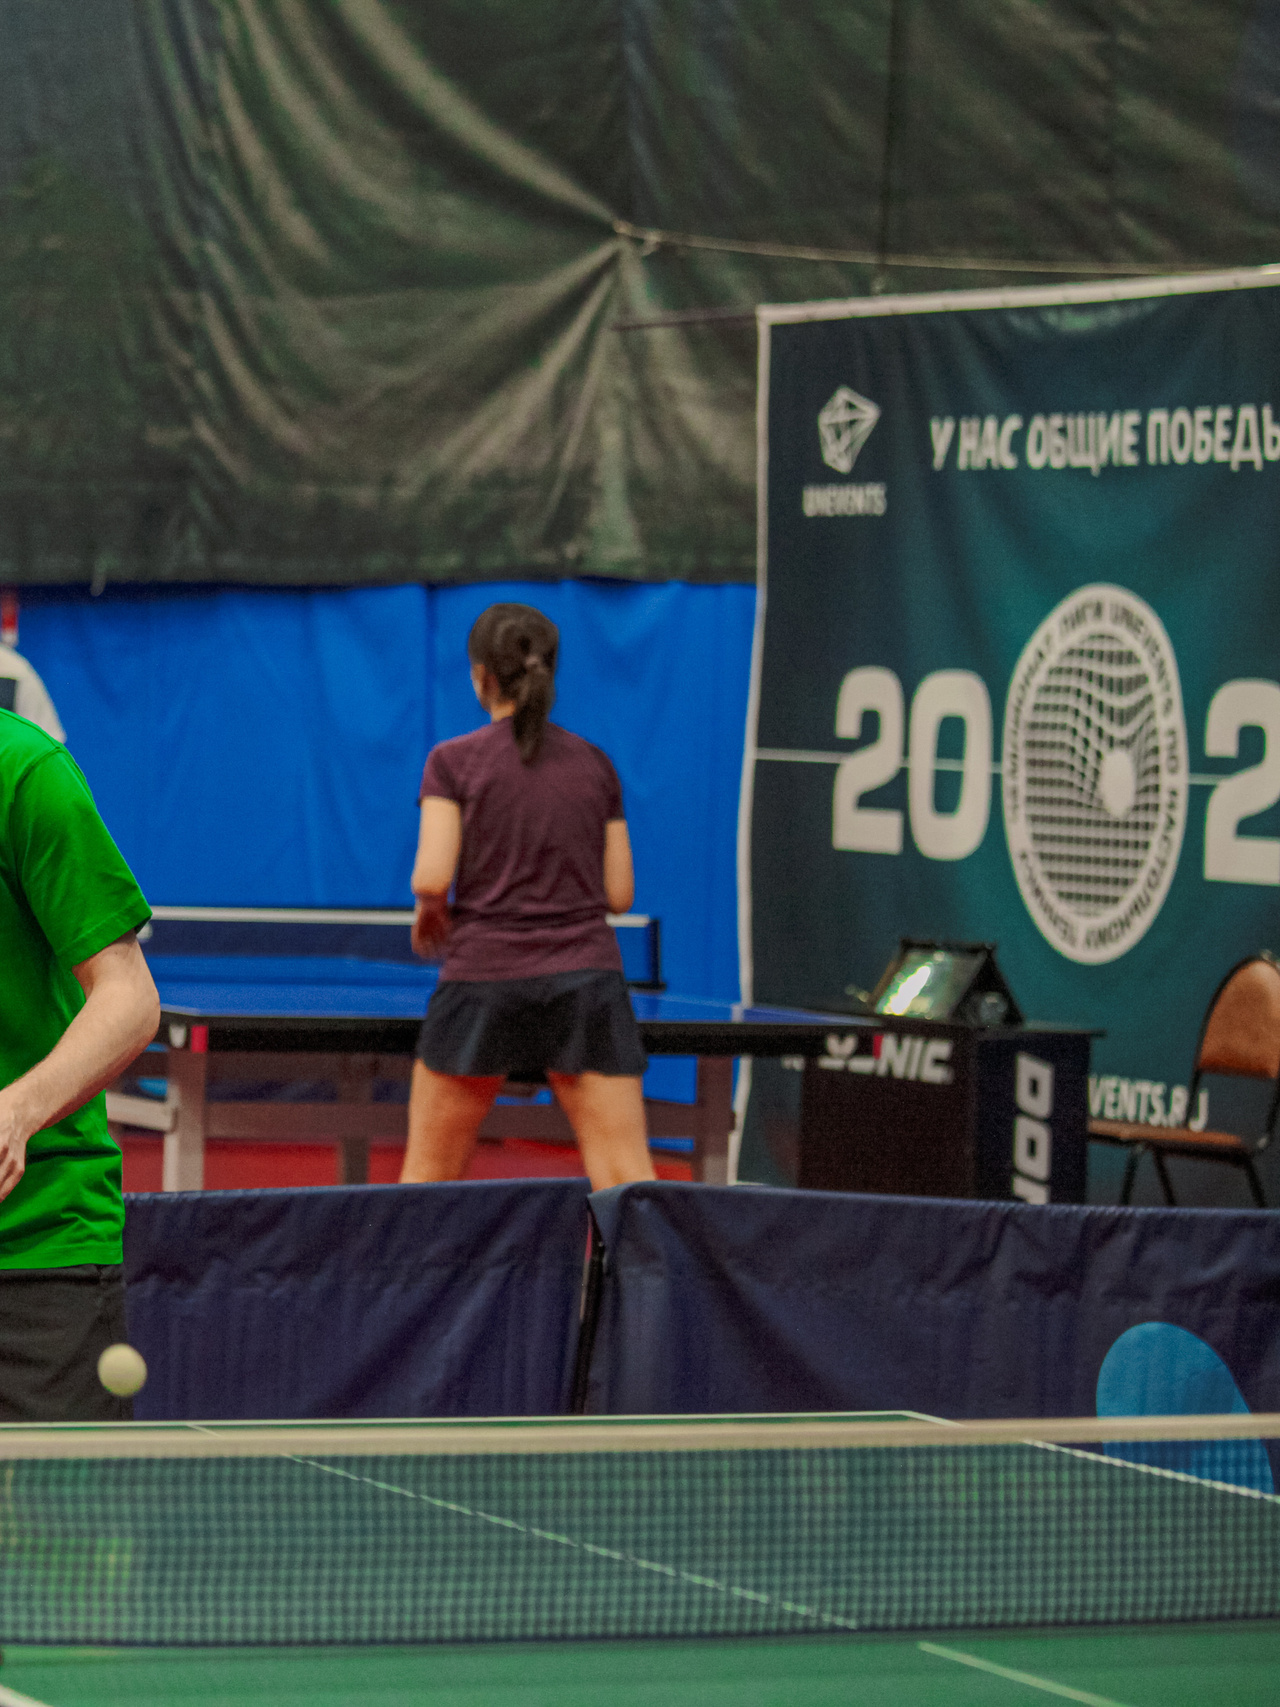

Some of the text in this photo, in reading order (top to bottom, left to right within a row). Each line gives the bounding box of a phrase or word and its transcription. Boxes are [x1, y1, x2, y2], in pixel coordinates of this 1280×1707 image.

[931, 417, 955, 470] У
[957, 414, 1022, 470] НАС
[1026, 410, 1142, 477] ОБЩИЕ
[831, 664, 993, 862] 20
